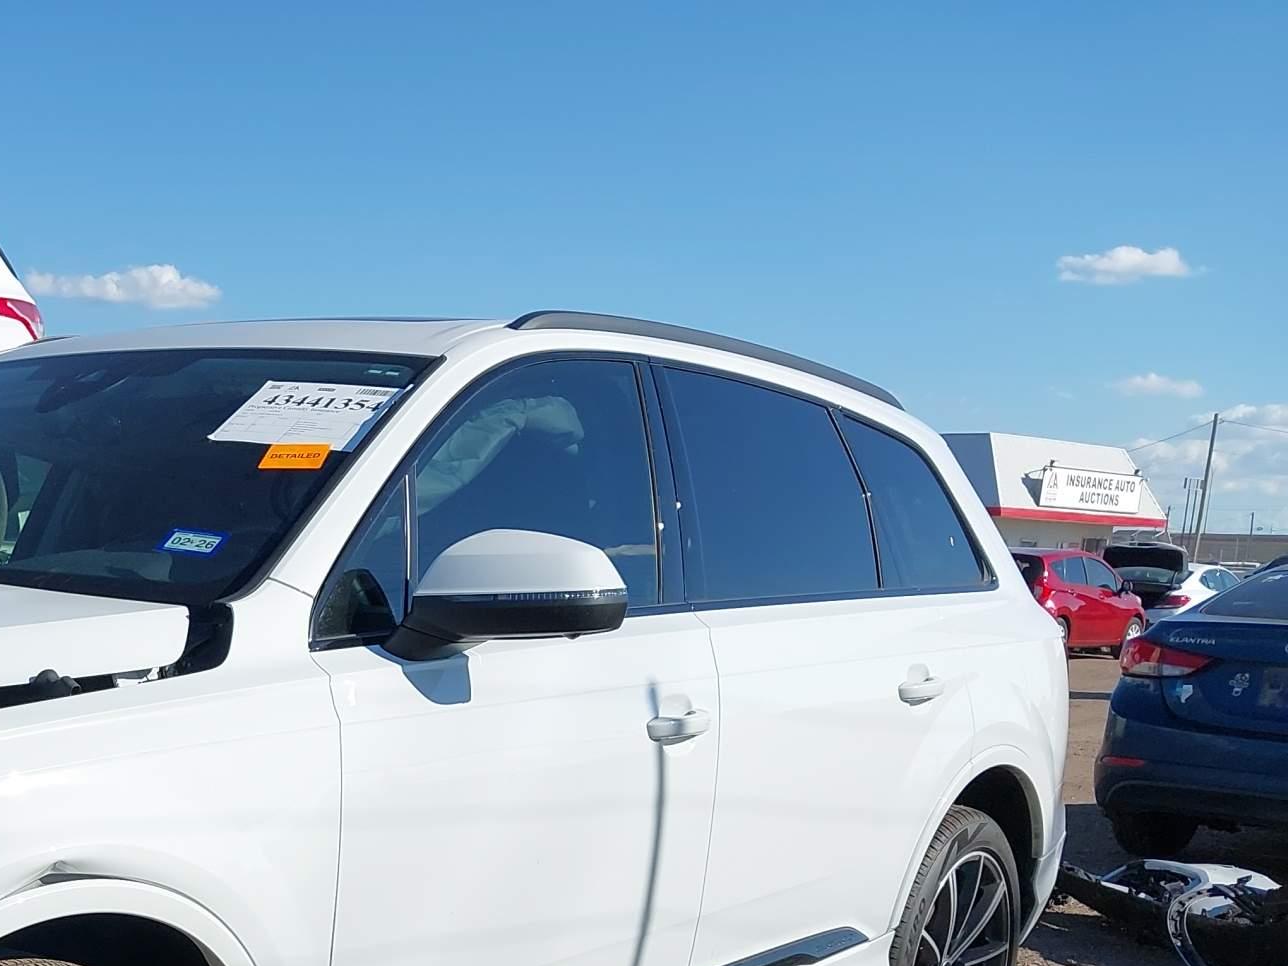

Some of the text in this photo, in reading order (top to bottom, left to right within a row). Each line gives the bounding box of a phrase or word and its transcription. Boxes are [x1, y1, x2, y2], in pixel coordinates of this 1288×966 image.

[262, 394, 384, 412] 43441354
[269, 451, 321, 460] DETAILED
[1066, 474, 1137, 493] INSURANCE AUTO
[1078, 493, 1120, 506] AUCTIONS
[171, 536, 217, 549] 02 26
[1169, 636, 1216, 645] ELANTRA
